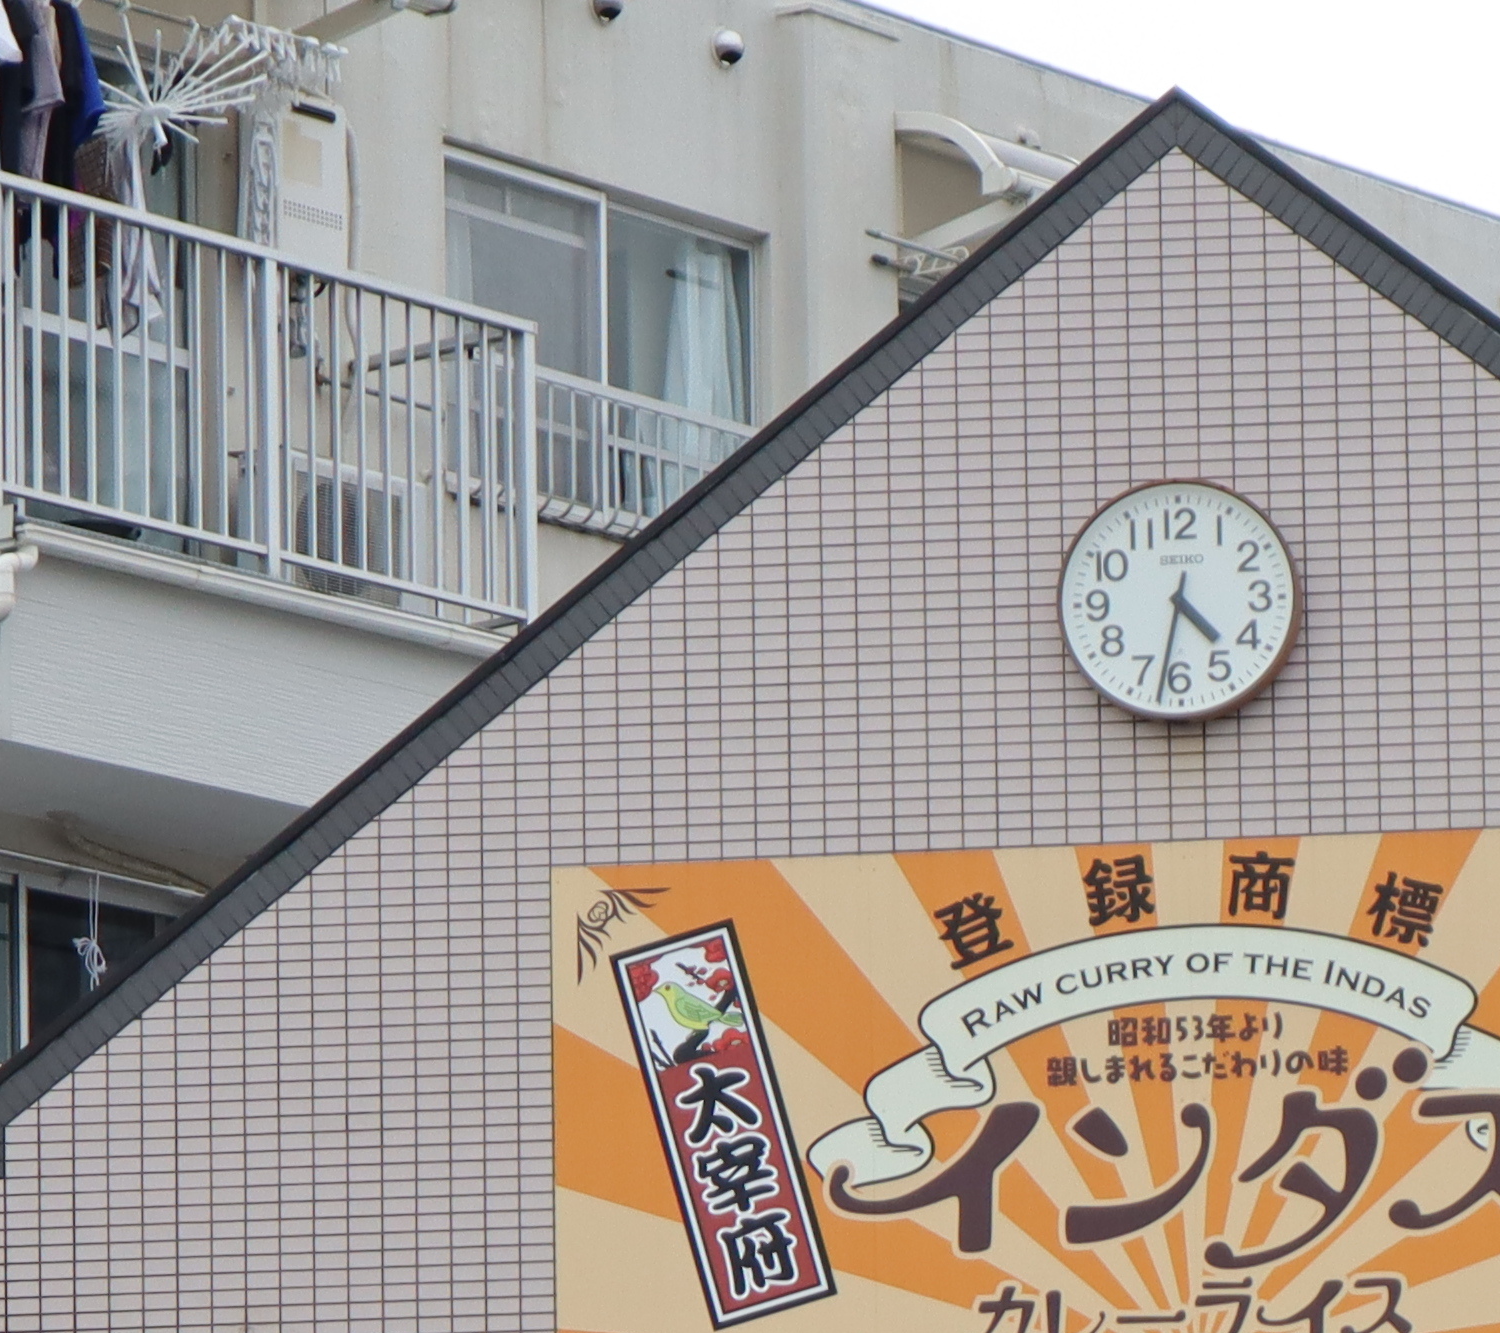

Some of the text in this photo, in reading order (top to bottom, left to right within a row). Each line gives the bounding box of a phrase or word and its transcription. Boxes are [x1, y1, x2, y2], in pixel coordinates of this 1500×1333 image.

[1129, 517, 1154, 551] 11
[1163, 507, 1198, 541] 12
[1215, 513, 1223, 547] 1
[1096, 548, 1129, 583] 10
[1159, 553, 1205, 567] SEIKO
[1236, 540, 1261, 573] 2
[1085, 588, 1111, 623] 9
[1247, 579, 1273, 613] 3
[1100, 624, 1125, 658] 8
[1235, 618, 1262, 651] 4
[1130, 654, 1156, 687] 7
[1166, 661, 1193, 695] 6
[1206, 650, 1233, 683] 5
[933, 851, 1444, 971] 登録商標
[960, 950, 1433, 1040] RAW CURRY OF THE INDAS
[1107, 1011, 1285, 1049] 昭和53年より
[1046, 1048, 1350, 1088] 親しまれるこだわりの味
[675, 1064, 799, 1301] 太宰府
